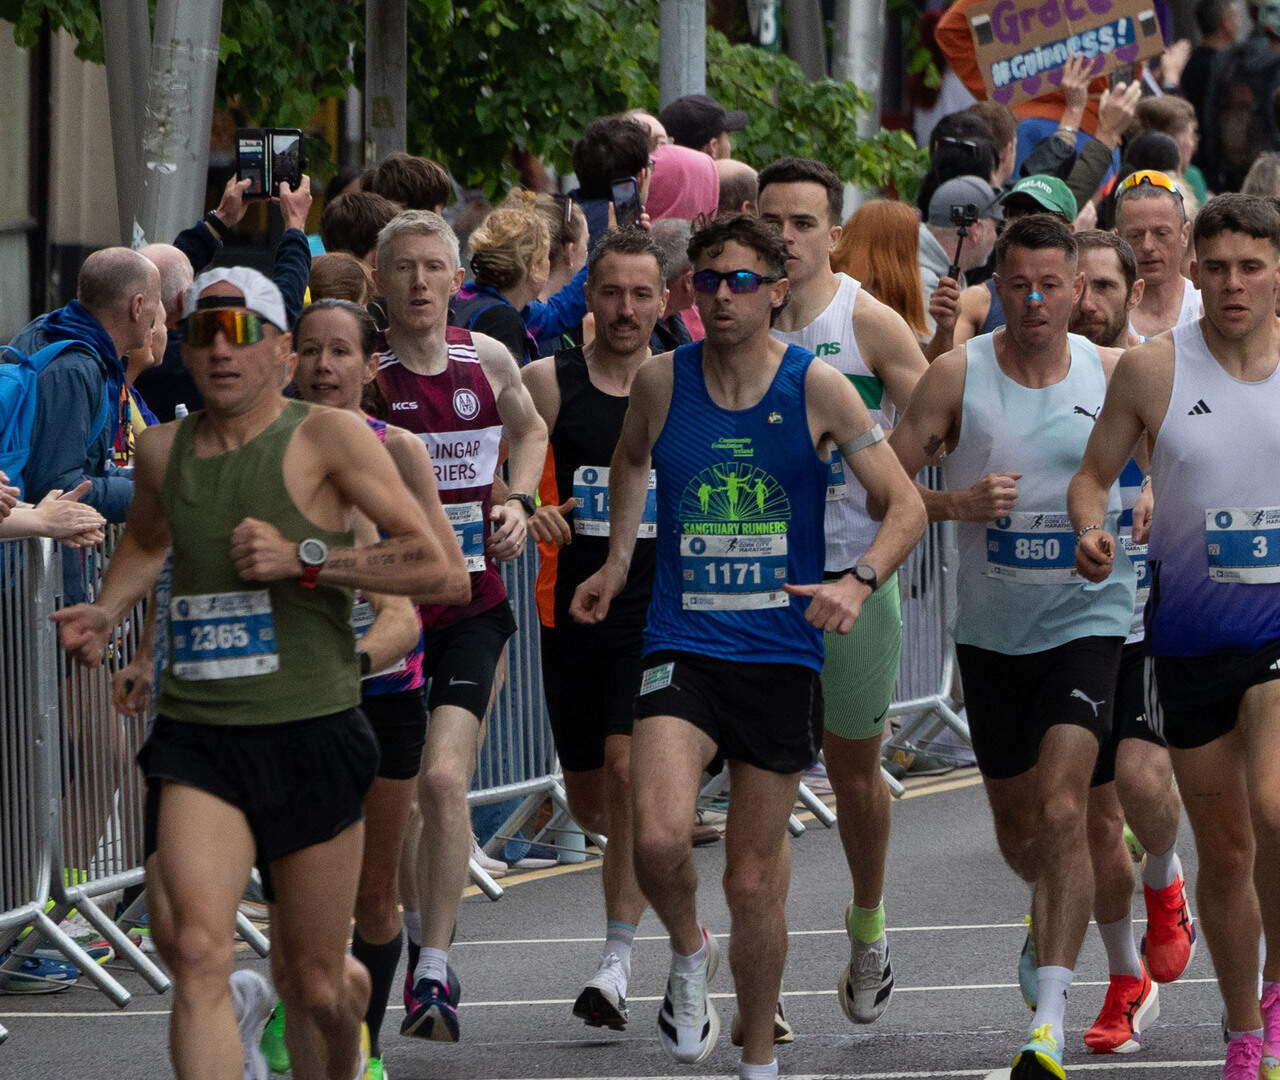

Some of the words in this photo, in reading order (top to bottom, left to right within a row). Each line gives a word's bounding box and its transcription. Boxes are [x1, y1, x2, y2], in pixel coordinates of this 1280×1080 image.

[392, 401, 418, 411] KCS
[683, 522, 740, 535] SANCTUARY
[741, 521, 788, 534] RUNNERS
[1015, 538, 1060, 560] 850
[1252, 535, 1268, 558] 3
[704, 562, 761, 584] 1171
[191, 622, 249, 651] 2365
